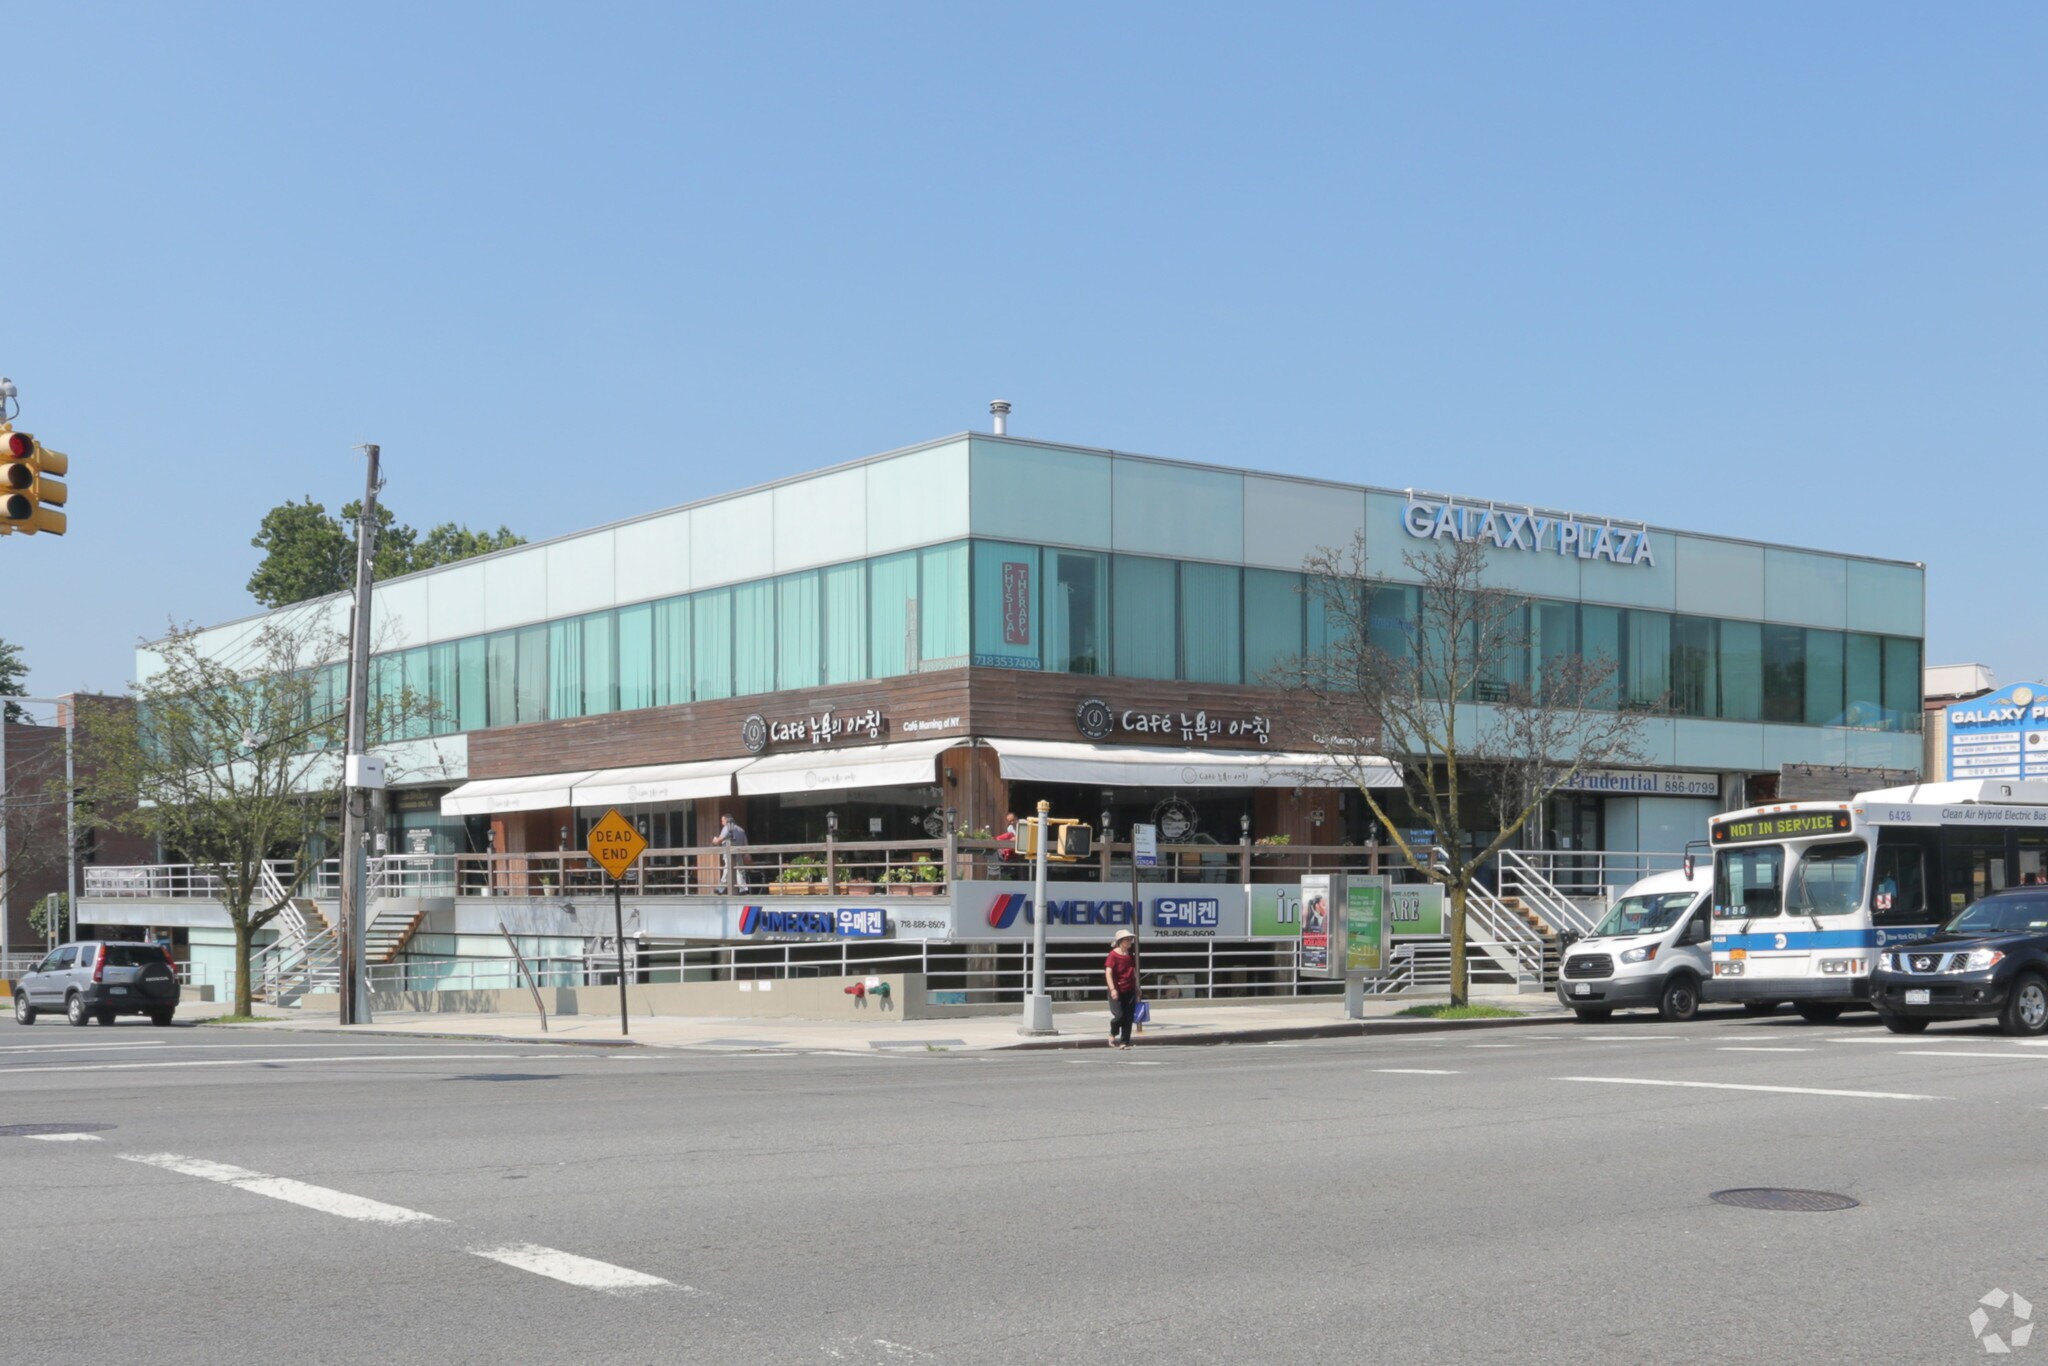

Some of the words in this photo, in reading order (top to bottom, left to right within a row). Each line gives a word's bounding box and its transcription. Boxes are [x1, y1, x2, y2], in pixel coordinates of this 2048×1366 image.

[1402, 500, 1549, 552] GALAXY
[1557, 520, 1656, 567] PLAZA
[1004, 564, 1015, 641] PHYSICAL
[1018, 570, 1027, 637] THERAPY
[975, 655, 1040, 668] 7183537400
[903, 720, 918, 732] Café
[919, 718, 943, 731] Morning
[950, 716, 960, 727] NY
[1951, 707, 2026, 724] GALAXY
[771, 720, 806, 741] Café
[811, 712, 842, 744] 뉴욕의
[847, 709, 881, 739] 아침
[1121, 709, 1172, 733] Café
[1180, 711, 1222, 742] 뉴욕의
[1229, 715, 1271, 745] 아침
[1568, 772, 1658, 792] Prudential
[1664, 780, 1716, 794] 886-0799
[1889, 810, 1912, 822] 6428
[1942, 808, 1963, 819] Clean
[1965, 809, 1976, 819] Air
[1978, 809, 2003, 821] Hybrid
[2004, 810, 2032, 821] Electric
[2033, 810, 2047, 821] Bus
[1730, 821, 1756, 837] NOT
[1758, 820, 1774, 835] IN
[1777, 815, 1834, 833] SERVICE
[596, 830, 632, 843] DEAD
[602, 848, 628, 860] END
[1157, 899, 1217, 926] 우메켄
[760, 911, 834, 934] UMEKEN
[838, 910, 882, 935] 우메켄
[900, 919, 946, 930] 718-886-8609
